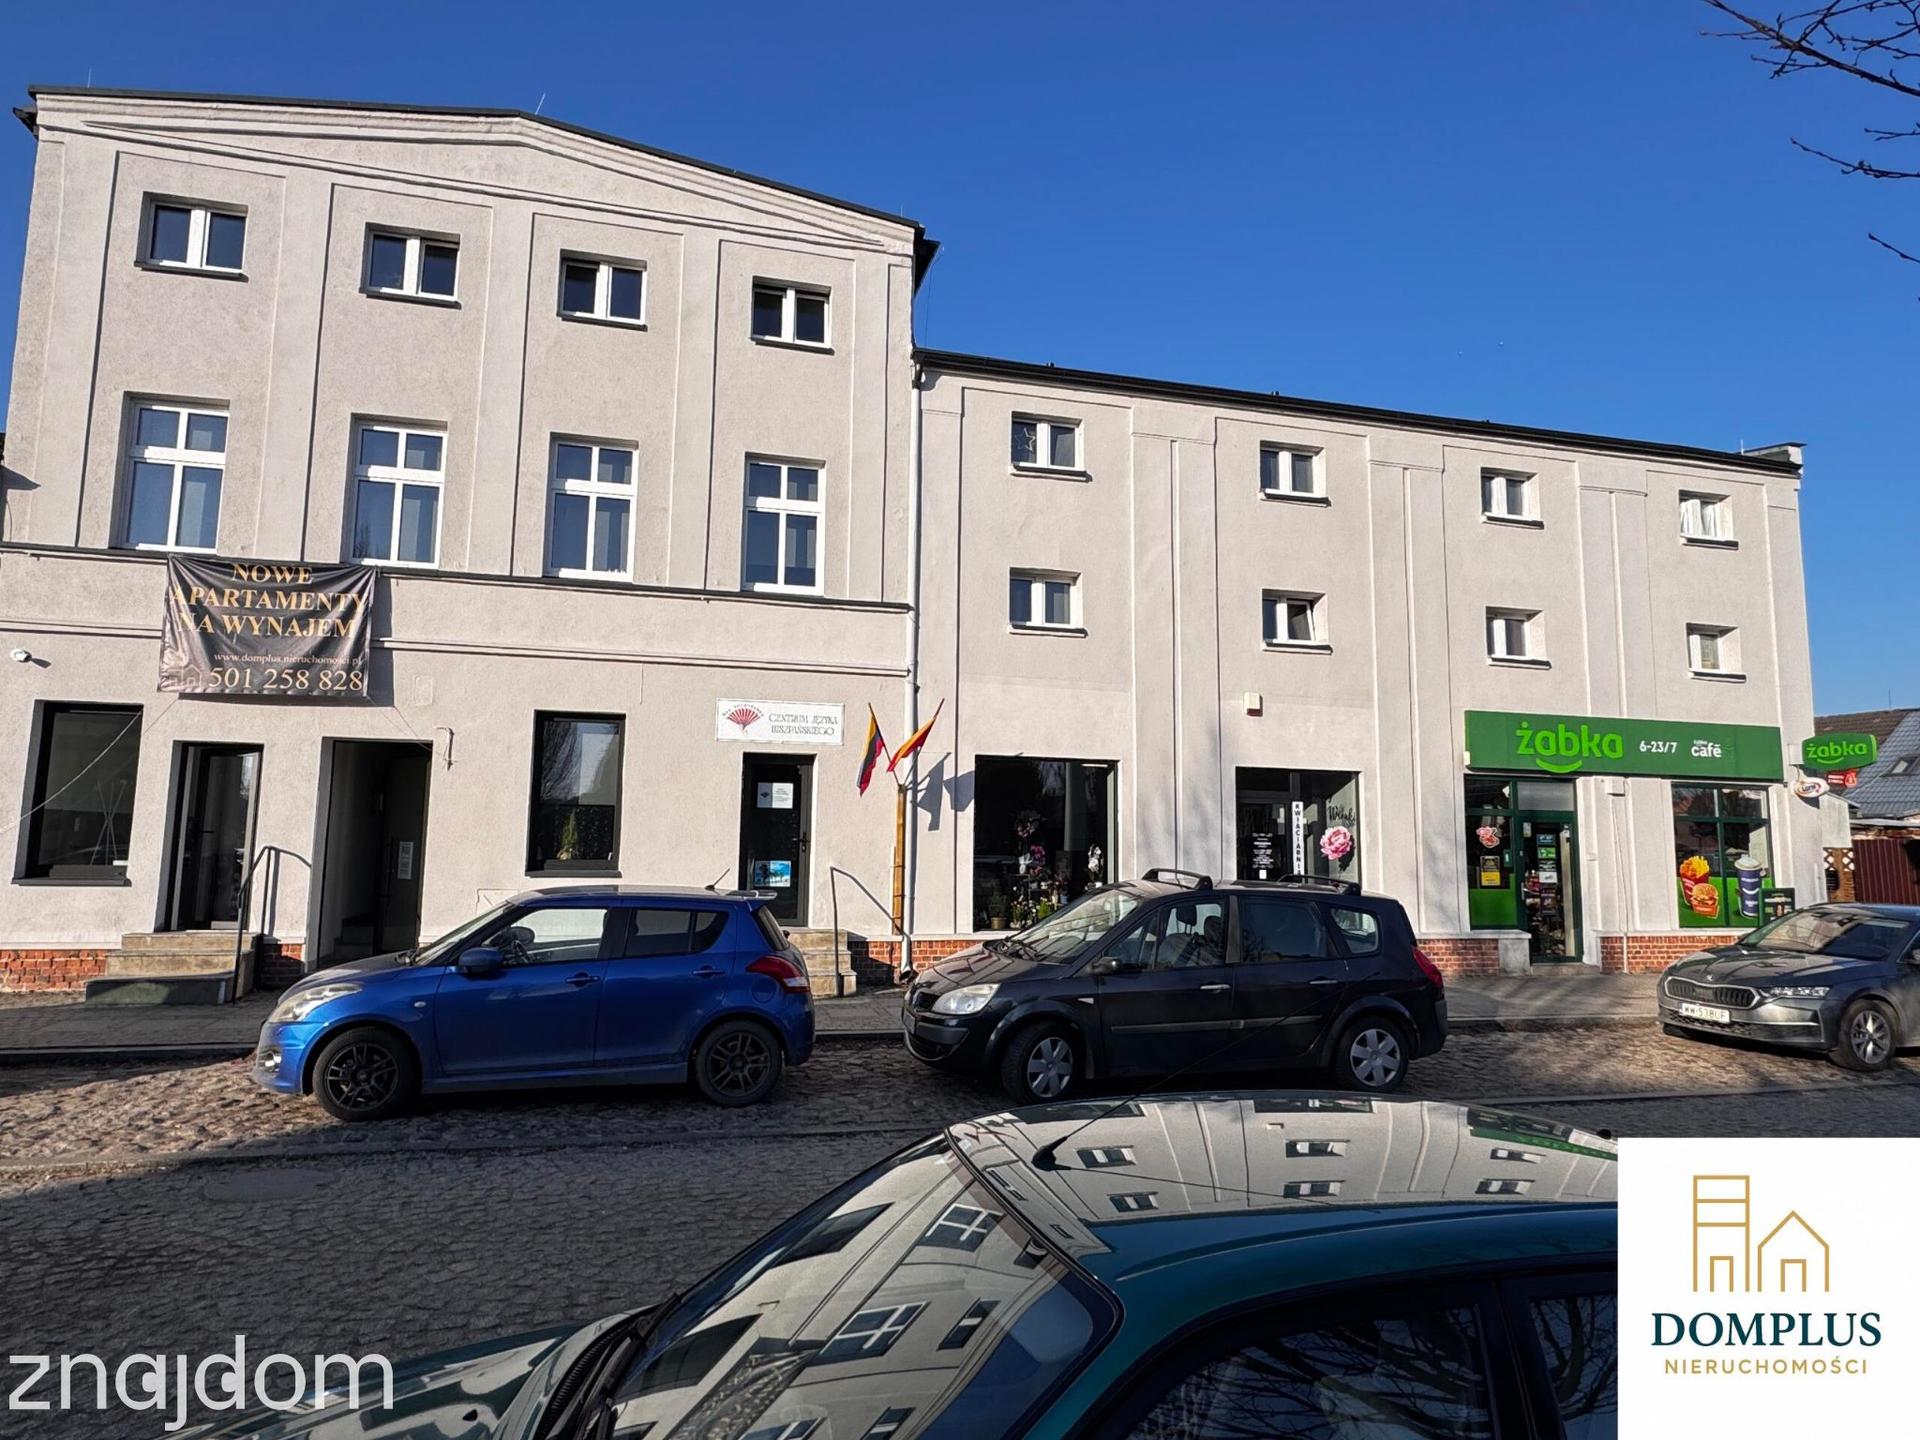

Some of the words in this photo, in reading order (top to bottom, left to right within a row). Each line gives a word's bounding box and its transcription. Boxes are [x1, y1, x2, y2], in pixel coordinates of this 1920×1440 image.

[232, 563, 314, 585] NOWE
[171, 585, 367, 612] APARTAMENTY
[178, 612, 215, 634] NA
[222, 613, 356, 638] WYNAJEM
[209, 667, 253, 688] 501
[263, 669, 310, 689] 258
[319, 670, 364, 691] 828
[768, 713, 809, 724] CENTRUM
[1515, 721, 1624, 759] żabka
[1639, 740, 1678, 754] 6-23/7
[1691, 742, 1722, 757] café
[1806, 740, 1868, 759] żabka
